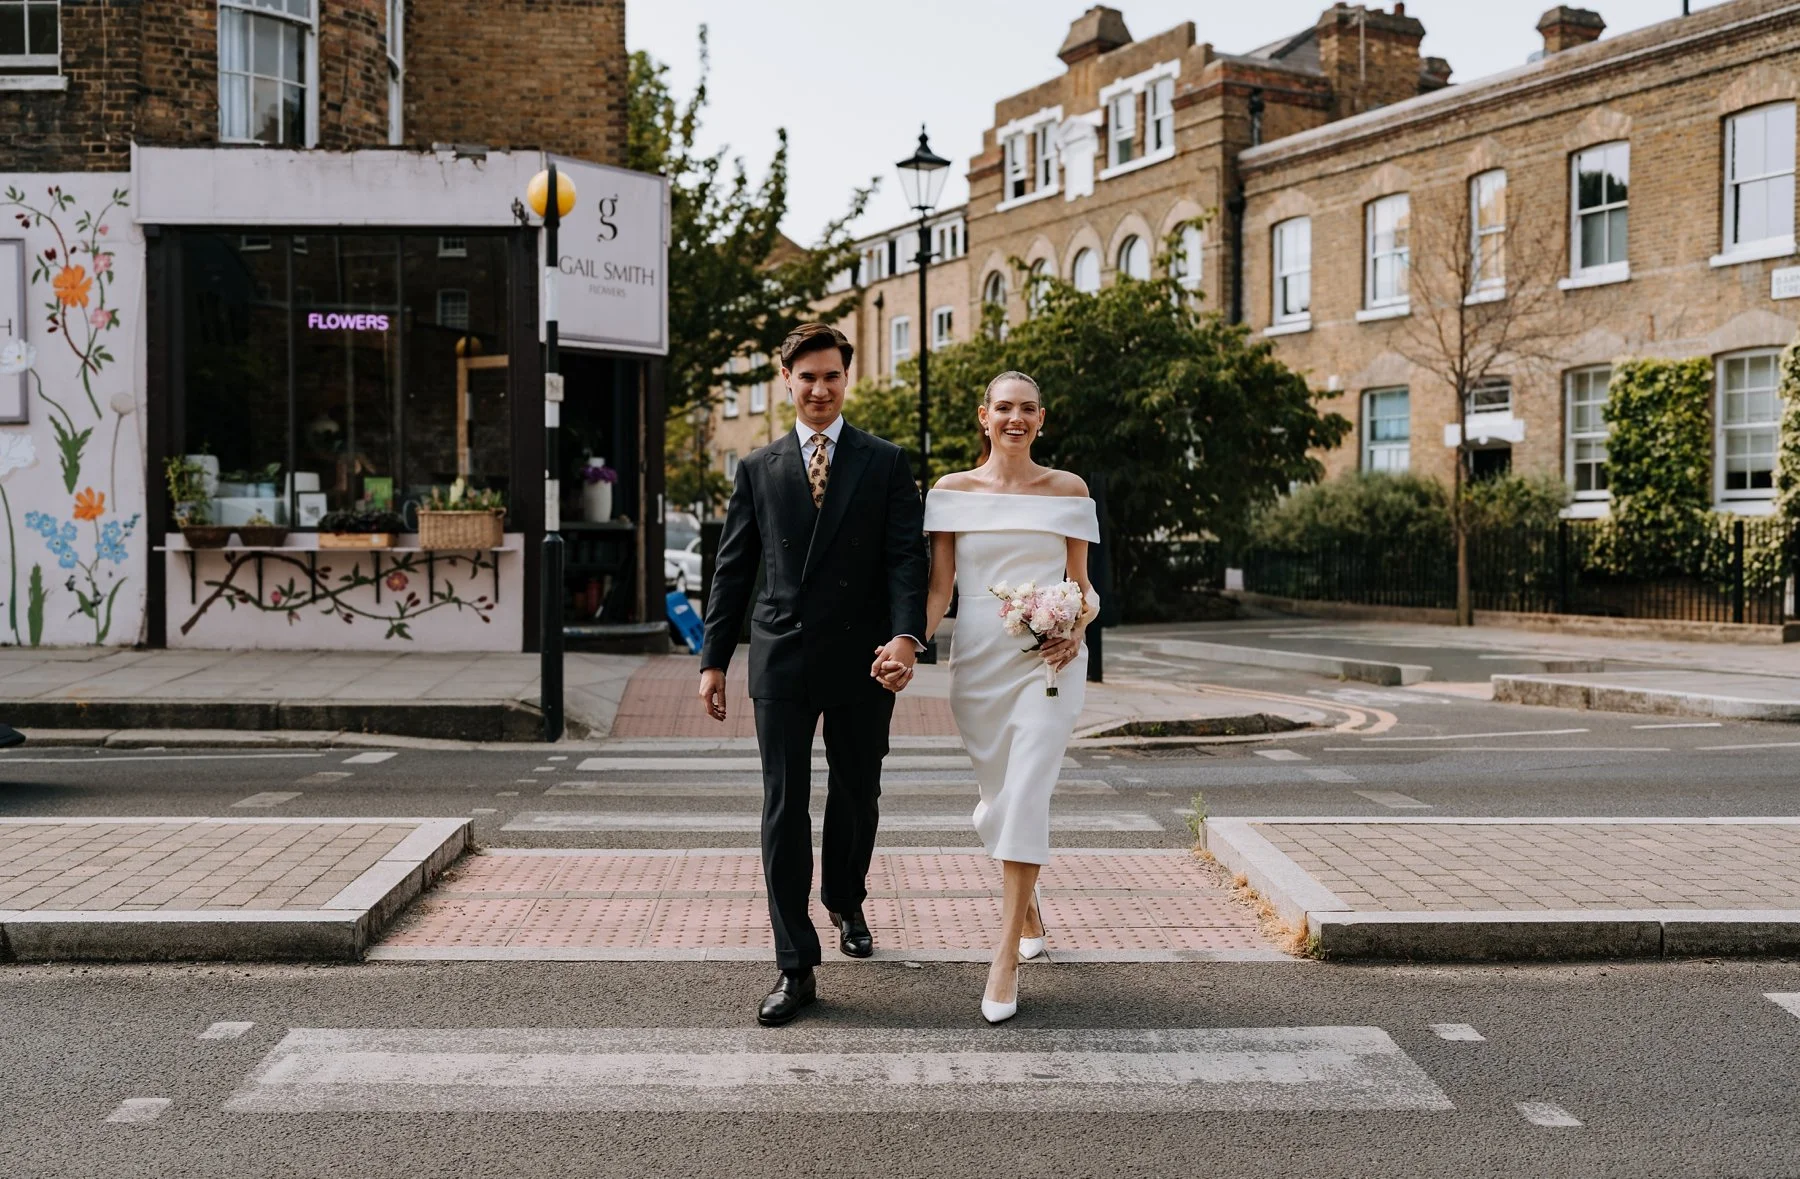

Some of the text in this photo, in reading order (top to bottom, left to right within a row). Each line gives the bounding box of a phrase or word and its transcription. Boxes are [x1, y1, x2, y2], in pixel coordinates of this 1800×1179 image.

[559, 255, 655, 286] GAIL SMITH
[589, 284, 626, 298] FLOWERS
[308, 313, 389, 331] FLOWERS
